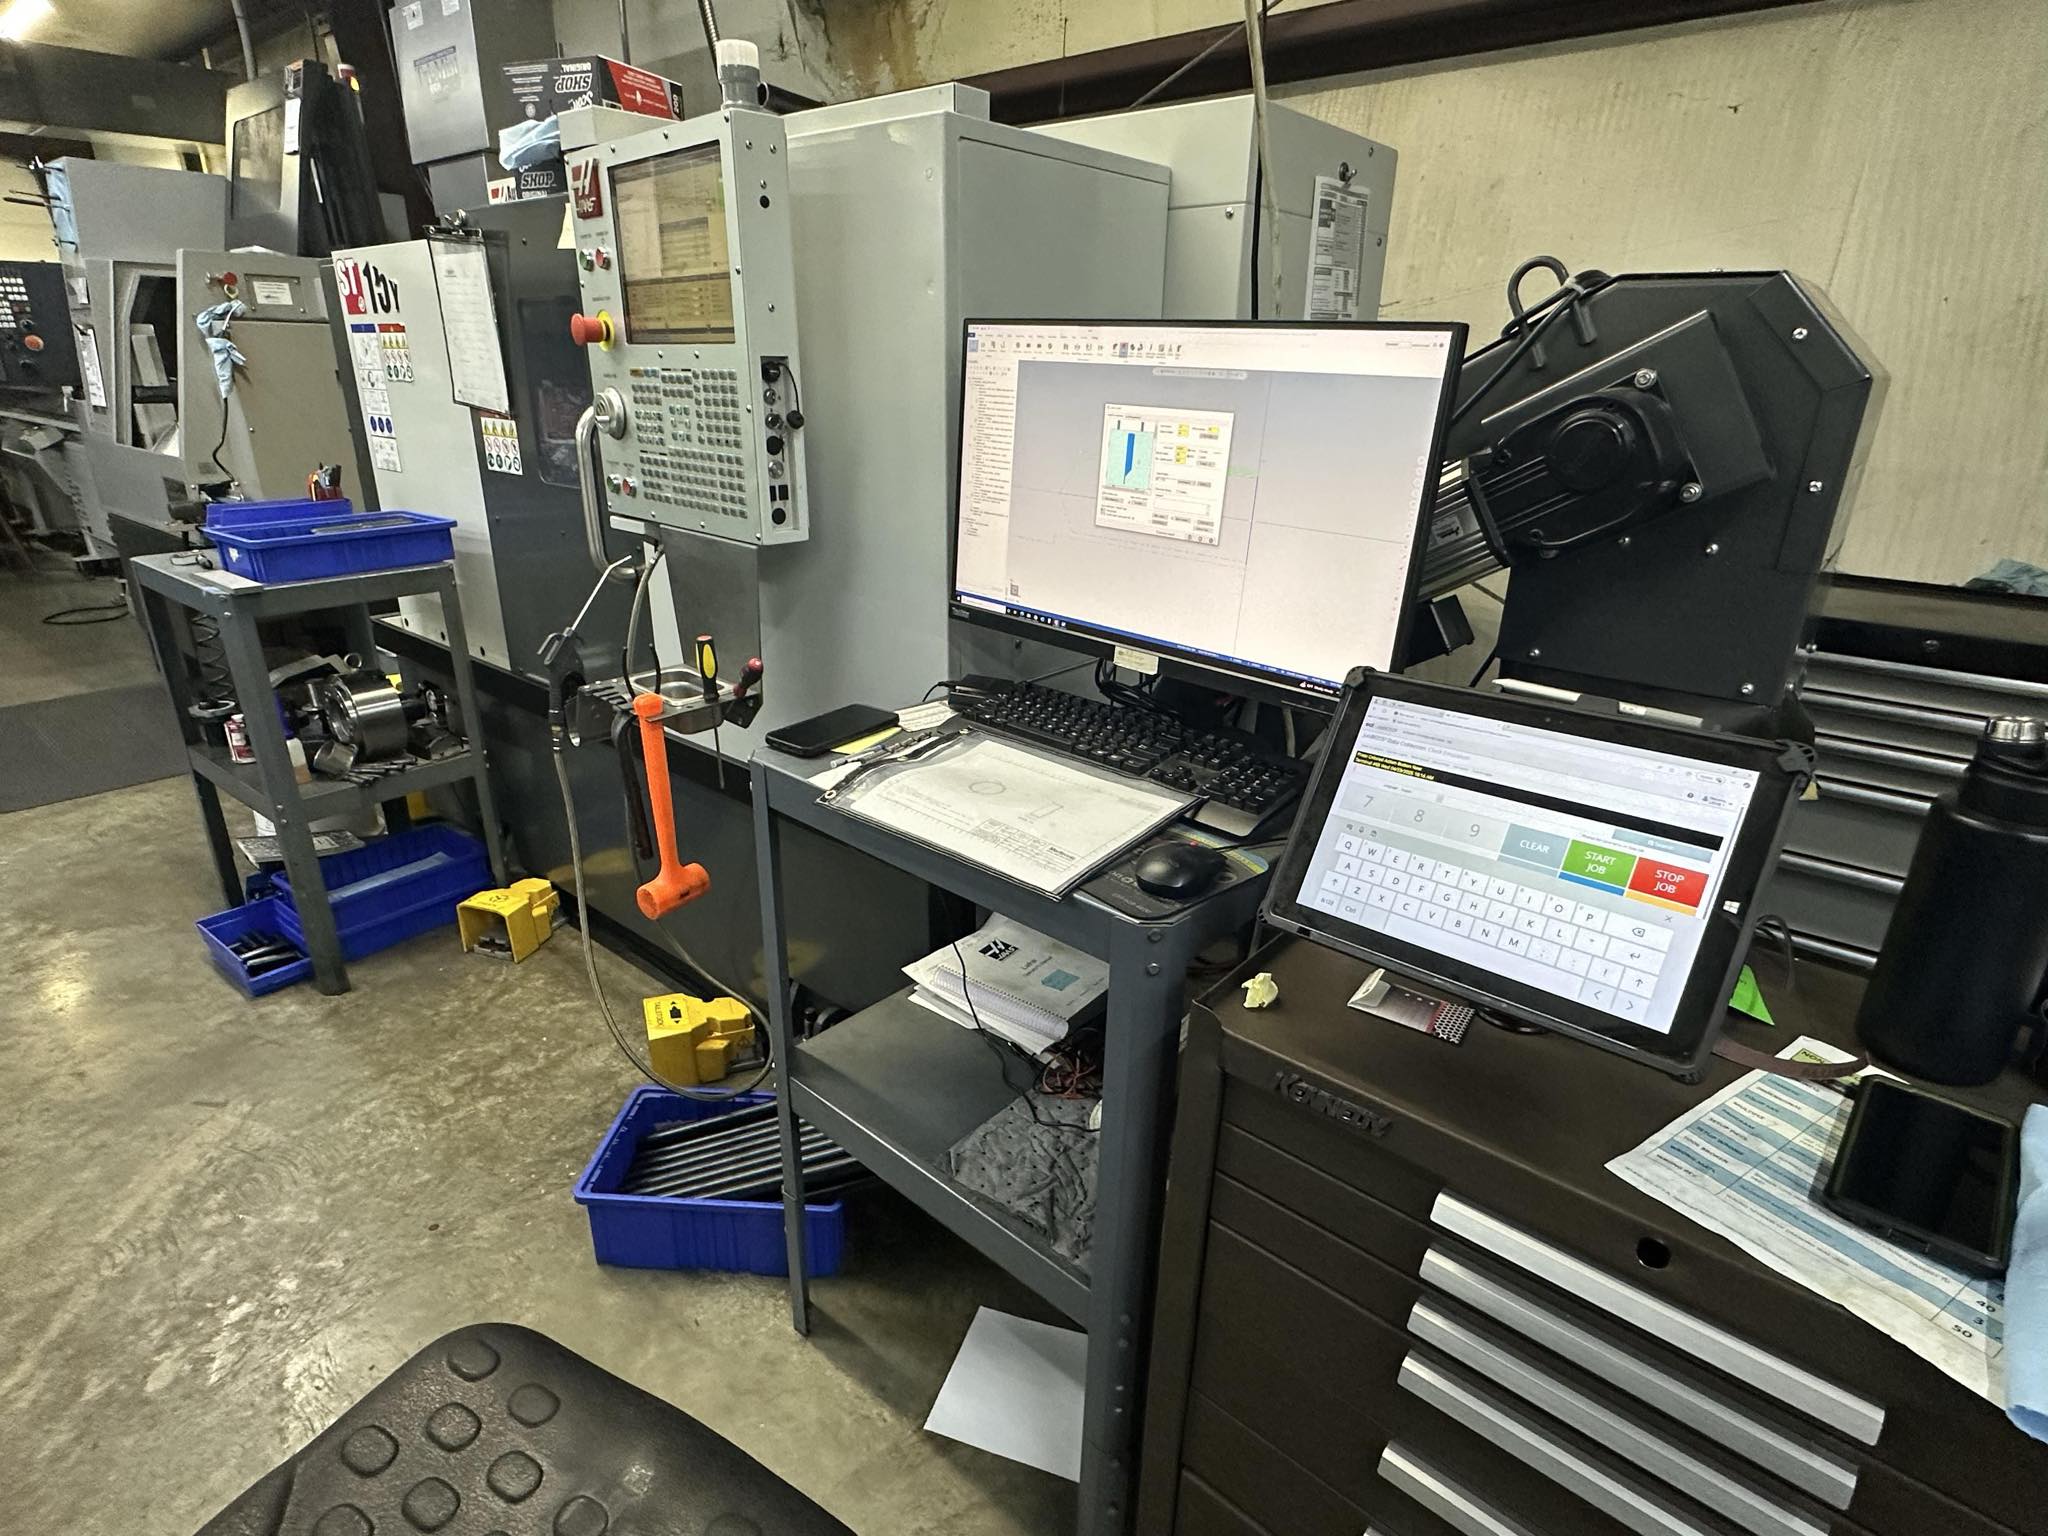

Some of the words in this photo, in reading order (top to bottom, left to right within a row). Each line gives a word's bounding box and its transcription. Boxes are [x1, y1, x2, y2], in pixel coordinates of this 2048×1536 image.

[554, 73, 592, 93] SHOP
[521, 171, 554, 188] SHOP
[336, 258, 358, 296] ST
[1363, 794, 1374, 808] 7
[1414, 809, 1425, 823] 8
[1470, 824, 1481, 838] 9
[1520, 840, 1550, 854] CLEAR
[1584, 850, 1616, 866] START
[1585, 863, 1607, 874] JOB
[1655, 870, 1685, 883] STOP
[1345, 841, 1352, 850] Q
[1368, 848, 1377, 856] W
[1418, 863, 1424, 871] R
[1496, 888, 1505, 896] U
[1554, 904, 1564, 913] O
[1586, 914, 1594, 922] P
[1653, 881, 1676, 894] JOB
[1345, 862, 1351, 870] A
[1368, 870, 1375, 878] S
[1392, 877, 1399, 885] D
[1470, 902, 1478, 910] H
[1498, 911, 1505, 919] J
[1527, 920, 1535, 928] K
[1557, 929, 1562, 938] L
[1345, 906, 1356, 914] Ctrl
[1403, 903, 1410, 911] C
[1455, 920, 1462, 928] B
[1481, 928, 1490, 938] N
[1508, 938, 1519, 947] M
[1976, 1300, 1996, 1313] 40
[1952, 1324, 1972, 1338] 50
